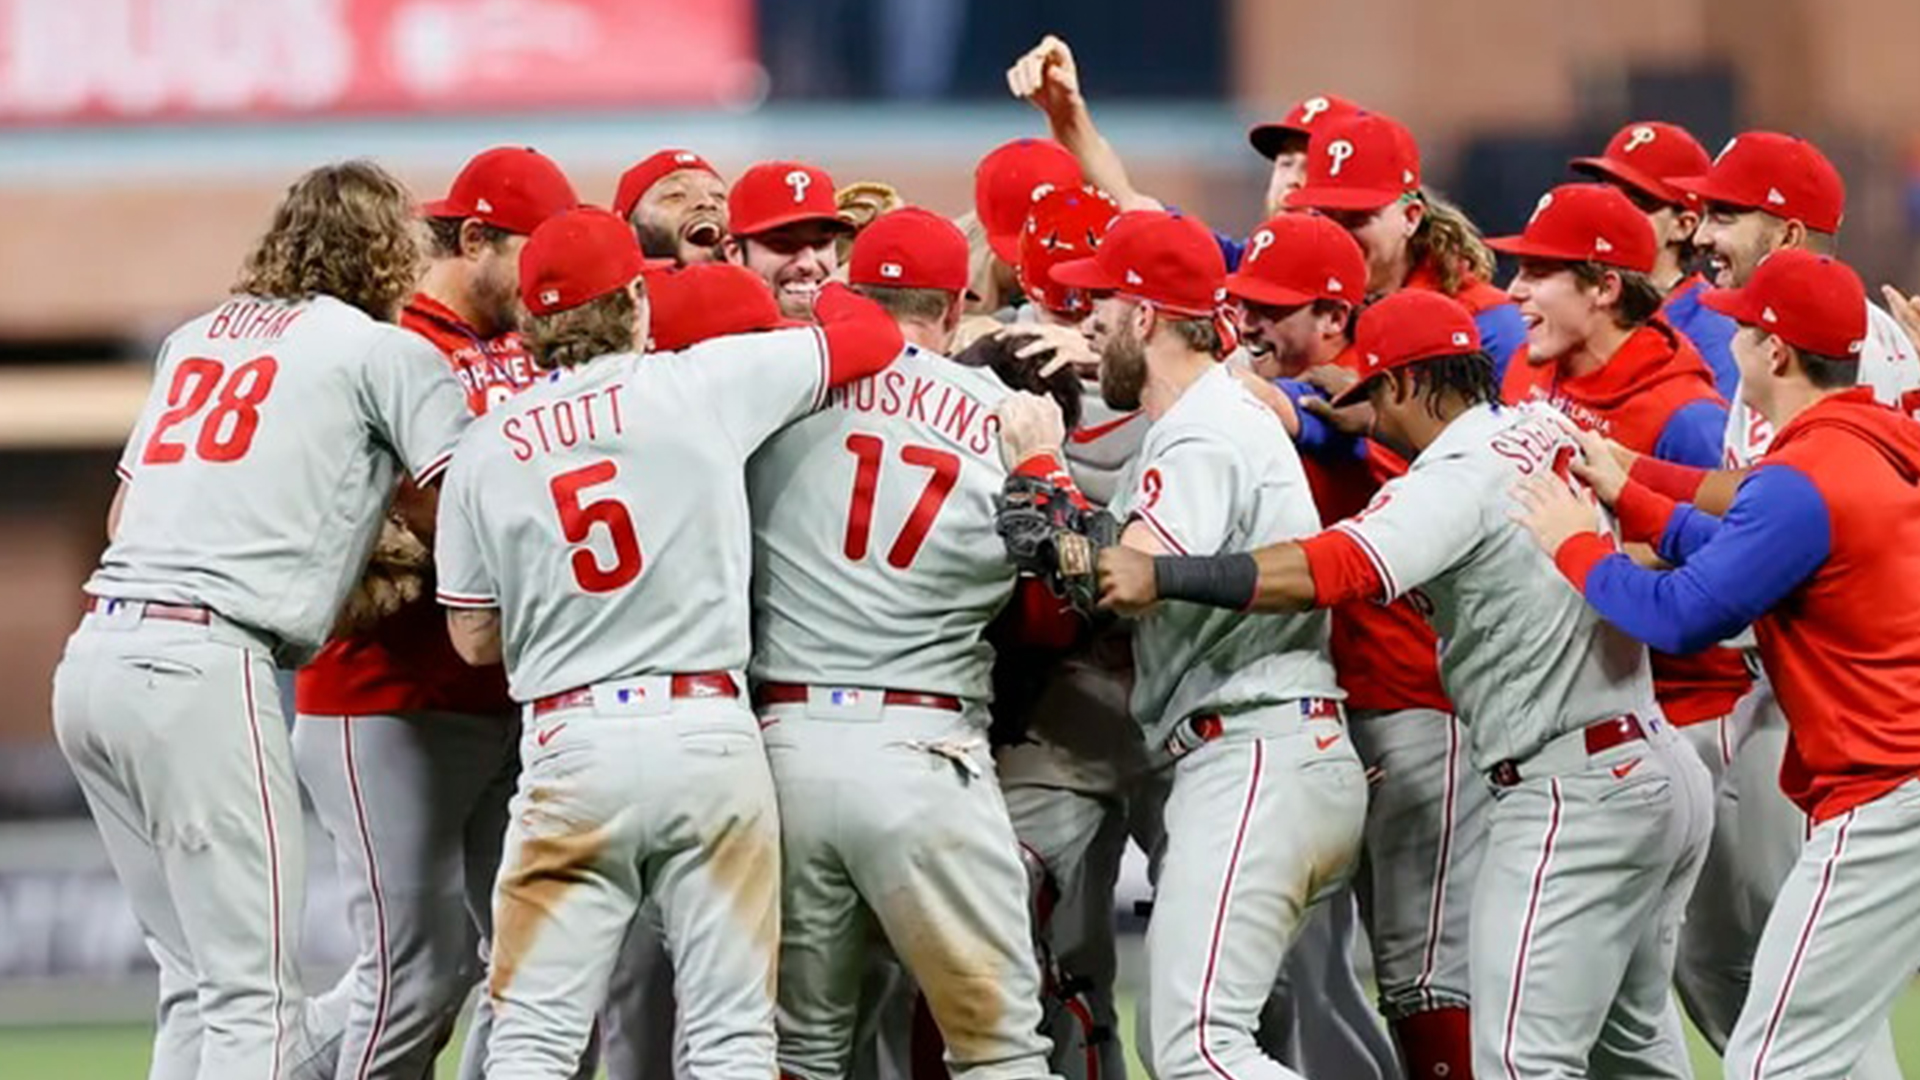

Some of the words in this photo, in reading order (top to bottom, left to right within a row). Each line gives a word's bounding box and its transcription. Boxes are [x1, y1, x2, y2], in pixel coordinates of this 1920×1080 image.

[1301, 97, 1329, 123] P
[1624, 127, 1655, 152] P
[1327, 140, 1353, 176] P
[785, 170, 811, 202] P
[1248, 230, 1275, 263] P
[207, 302, 304, 339] BOHM
[142, 356, 278, 465] 28
[502, 384, 624, 461] STOTT
[843, 433, 961, 570] 17
[550, 459, 643, 593] 5
